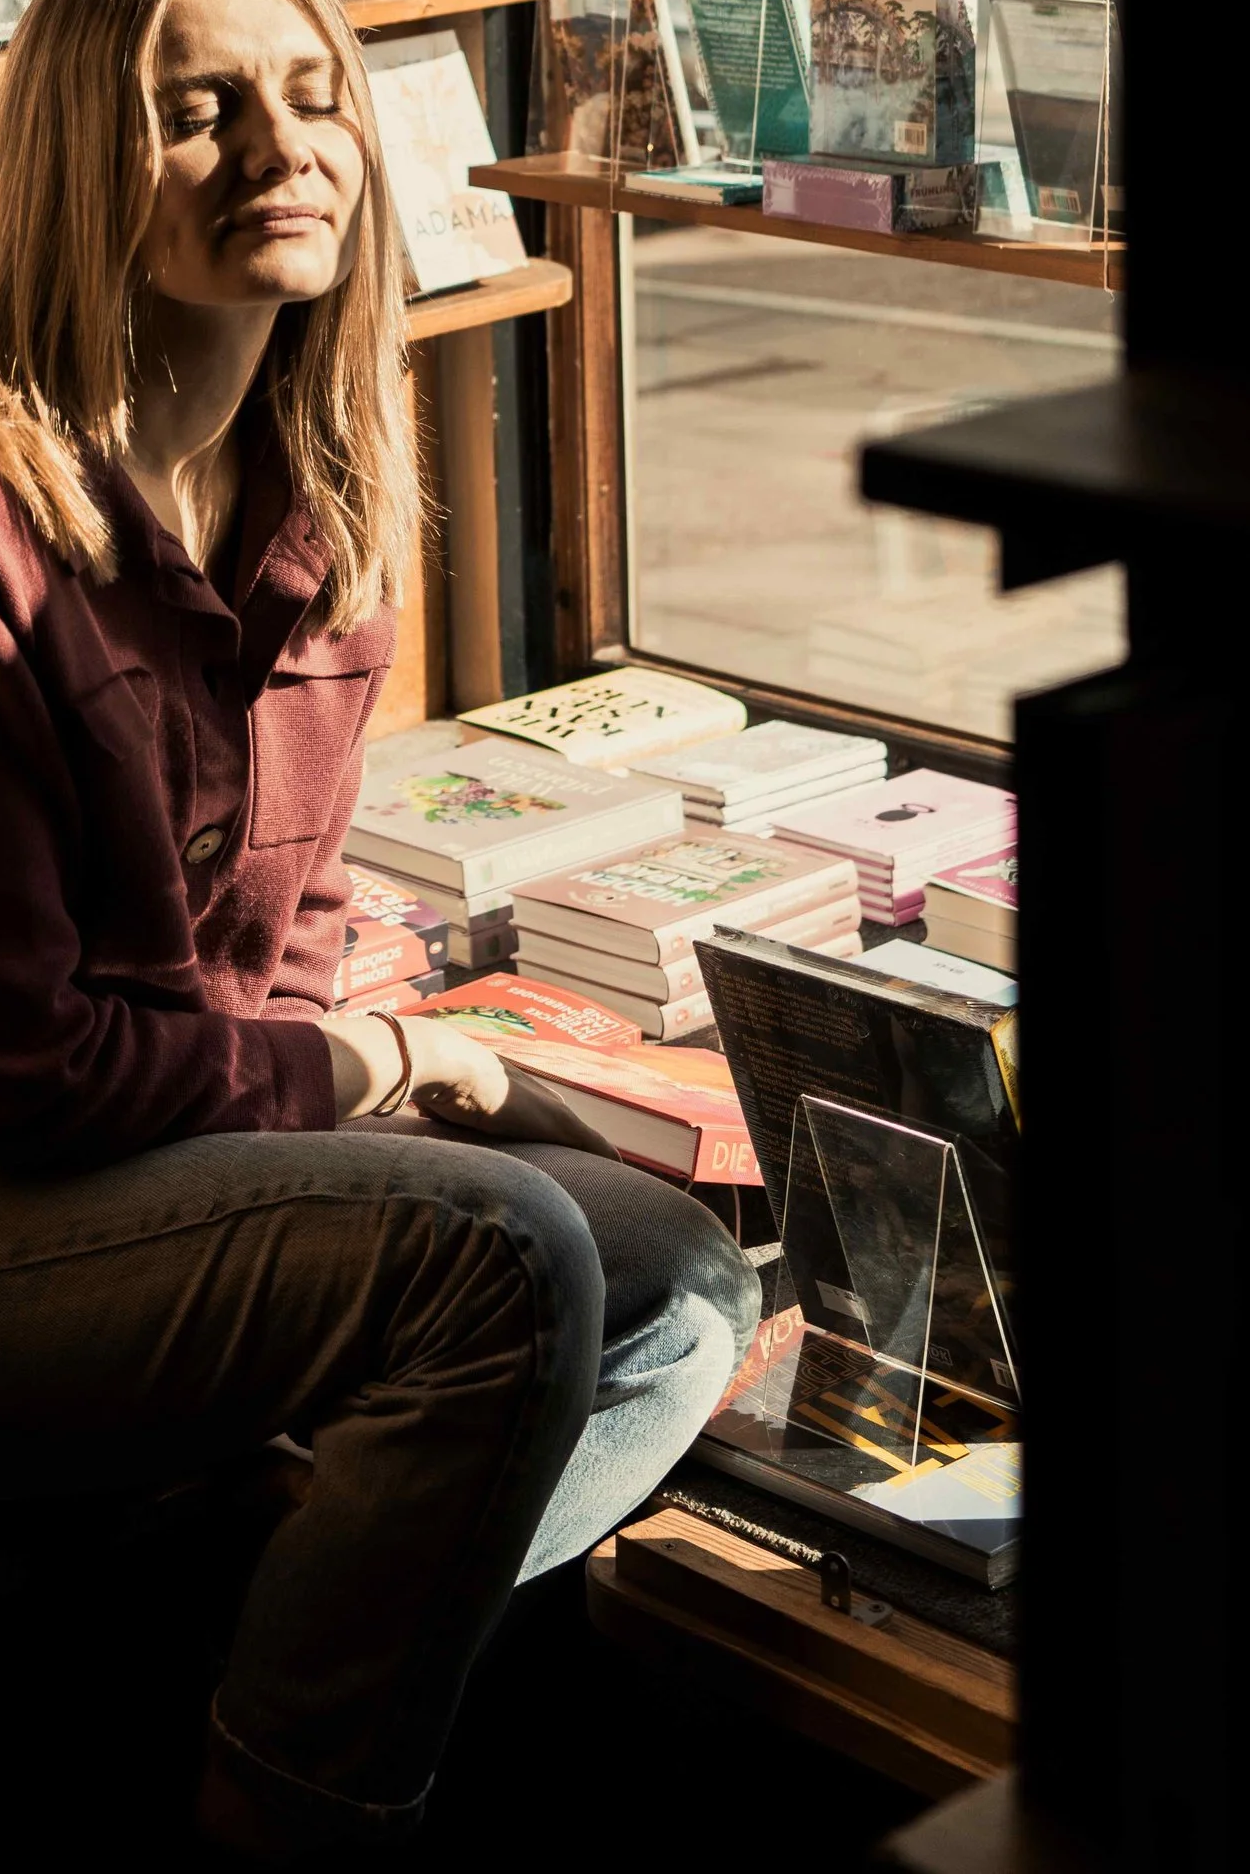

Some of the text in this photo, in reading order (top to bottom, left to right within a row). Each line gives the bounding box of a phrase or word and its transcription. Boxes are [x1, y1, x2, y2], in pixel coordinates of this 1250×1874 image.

[350, 945, 403, 972] SCHÖLER
[350, 964, 393, 989] LEONIE
[523, 1007, 590, 1042] EINBLICKE
[582, 1007, 621, 1029] LAND
[712, 1141, 748, 1172] DIE
